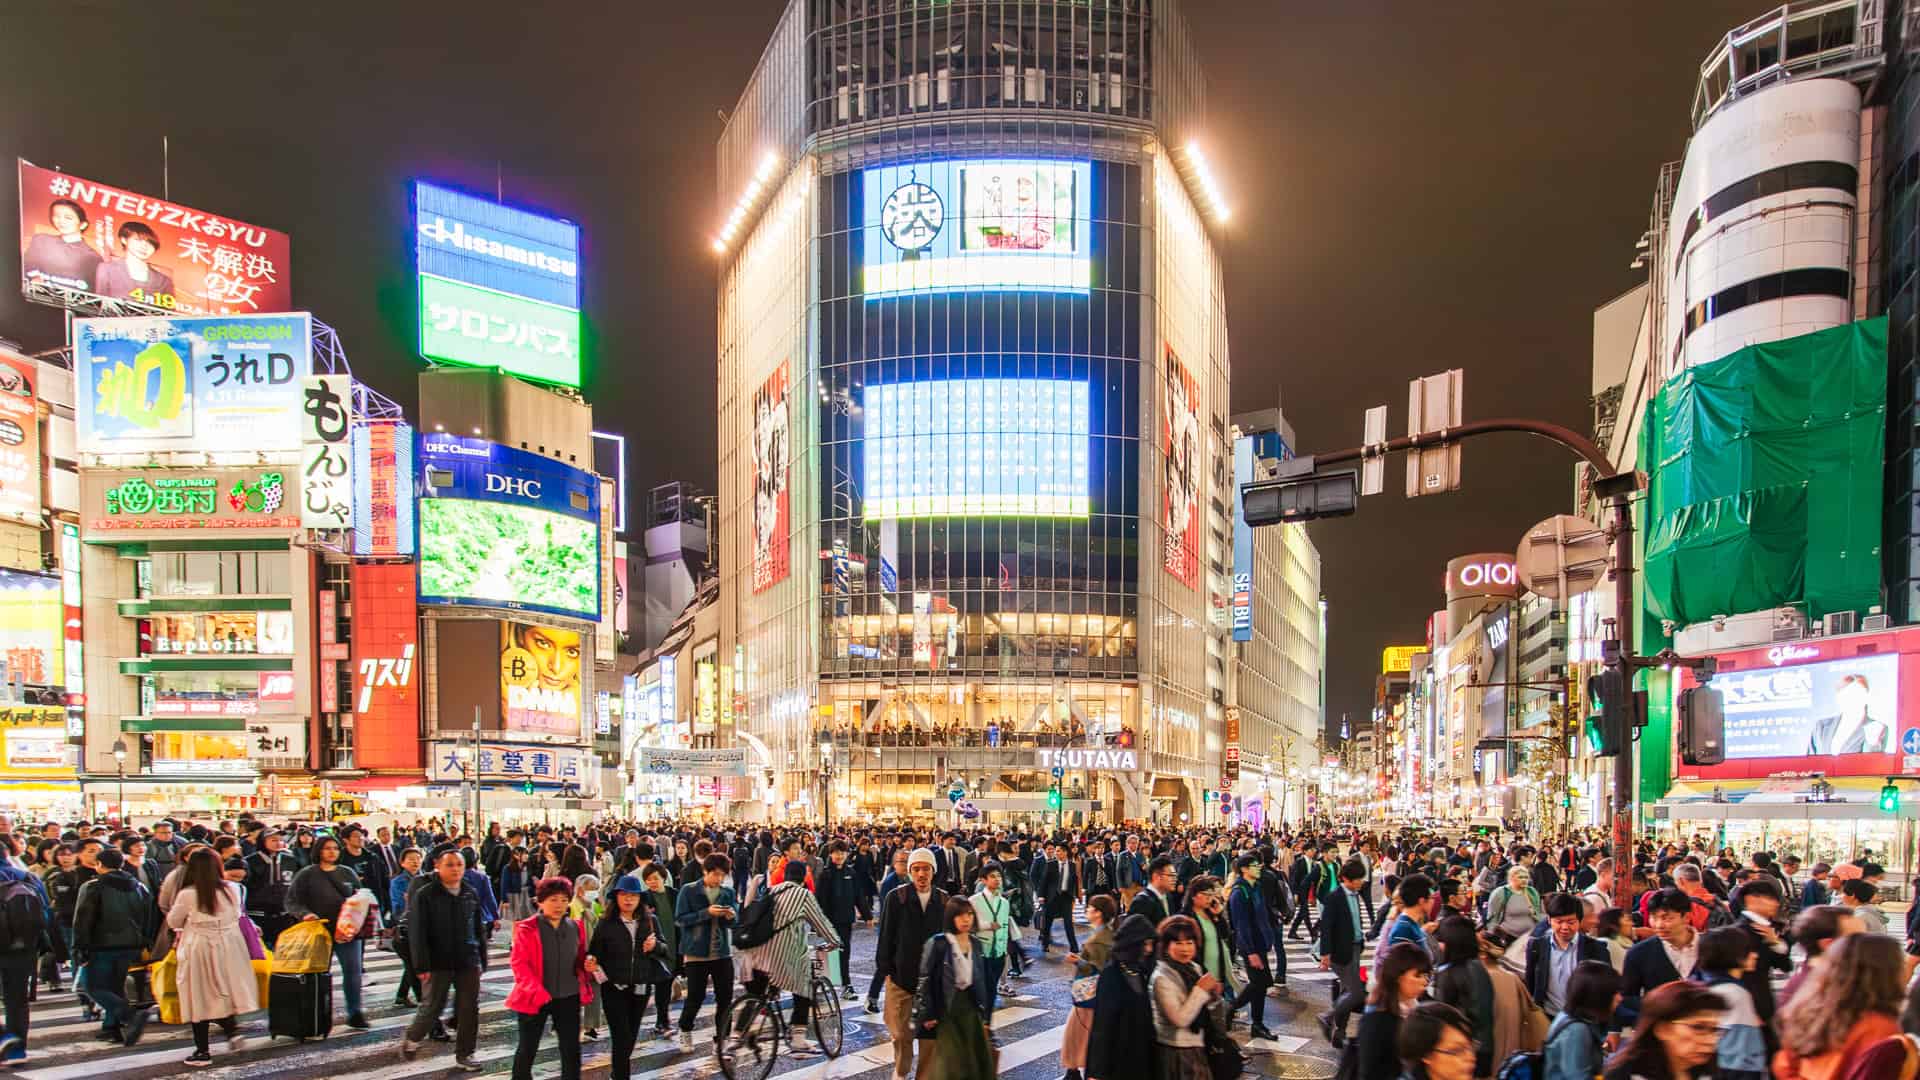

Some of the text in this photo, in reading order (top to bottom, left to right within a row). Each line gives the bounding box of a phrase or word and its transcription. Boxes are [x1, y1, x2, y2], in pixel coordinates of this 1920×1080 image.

[178, 236, 277, 283] 未解決
[419, 217, 577, 277] Hisamitsu
[203, 272, 262, 309] の女
[429, 303, 573, 358] サロンパス
[204, 353, 294, 387] うれD
[303, 379, 350, 525] もんじゃ
[156, 489, 216, 514] 西村
[485, 473, 541, 499] DHC
[1234, 573, 1249, 629] SEIBU
[156, 637, 257, 655] Euphoria
[358, 644, 414, 713] クスリ
[443, 751, 577, 777] 大盛堂書店
[1039, 751, 1136, 769] TSUTAYA
